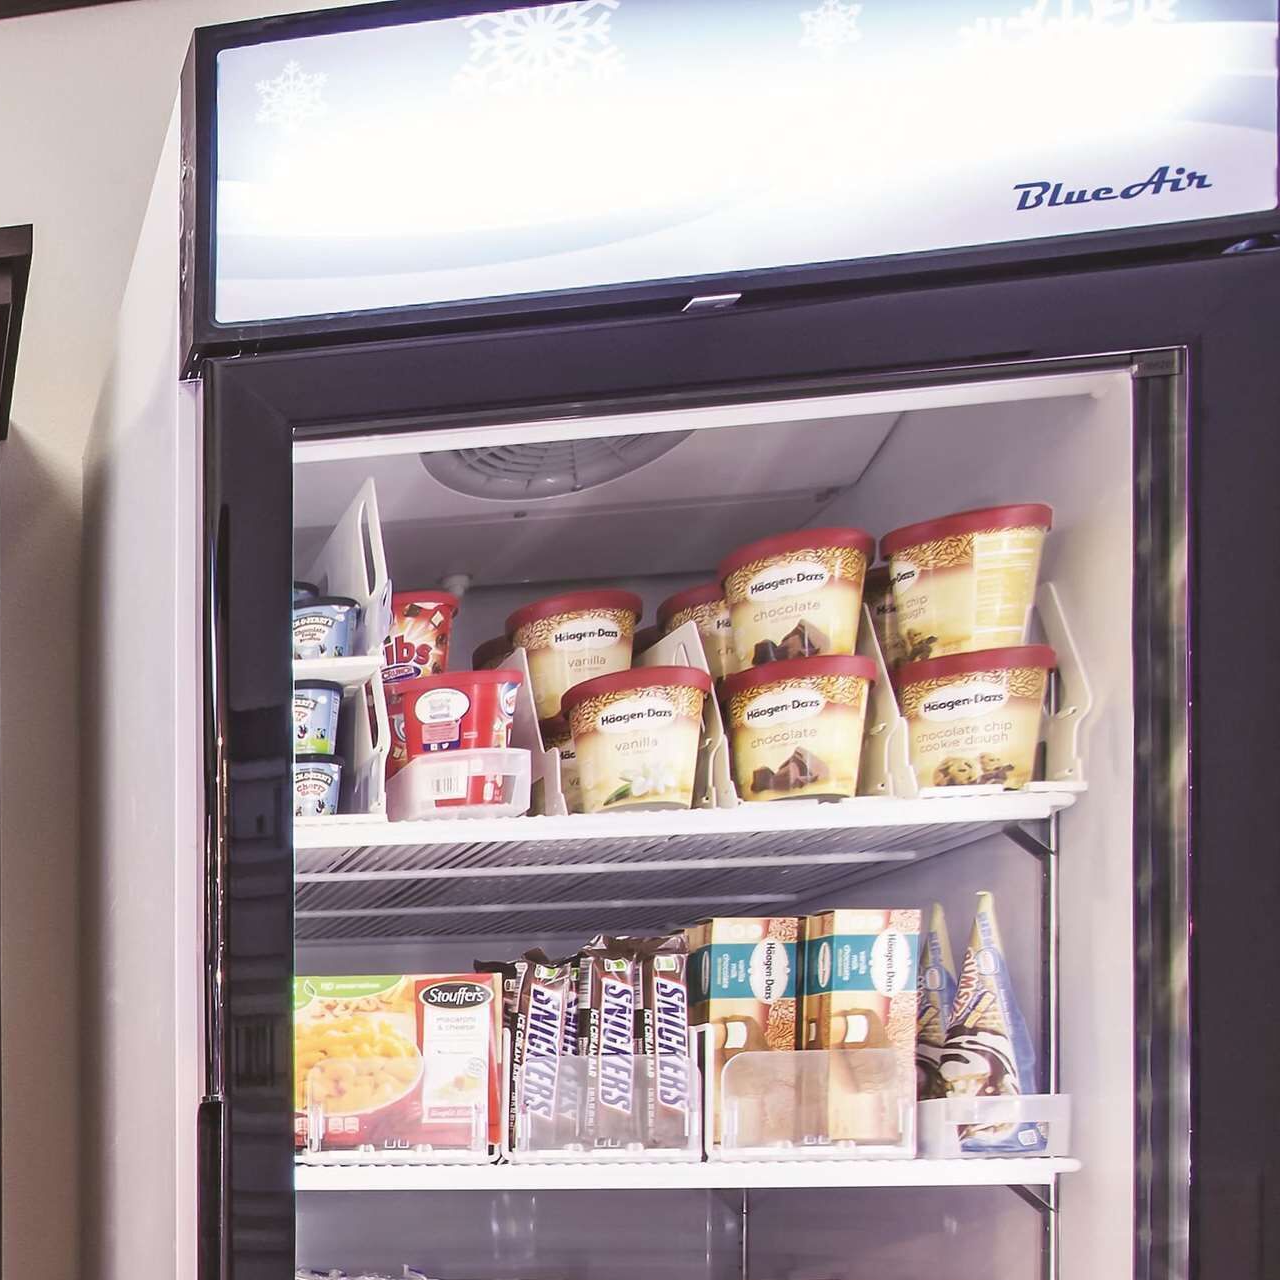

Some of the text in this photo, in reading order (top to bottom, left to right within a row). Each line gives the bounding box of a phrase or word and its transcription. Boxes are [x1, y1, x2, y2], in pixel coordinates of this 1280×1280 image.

[752, 598, 822, 623] chocolate
[567, 654, 607, 669] vanilla
[745, 697, 821, 721] Häagen-Dazs
[614, 735, 660, 753] vanilla
[750, 726, 819, 750] chocolate
[915, 718, 1014, 745] chocolate chip
[918, 729, 1010, 754] cookie dough
[428, 984, 486, 1006] Stouffer's
[524, 986, 562, 1119] SNICKERS
[601, 979, 633, 1114] SNICKERS
[655, 979, 688, 1111] SNICKERS
